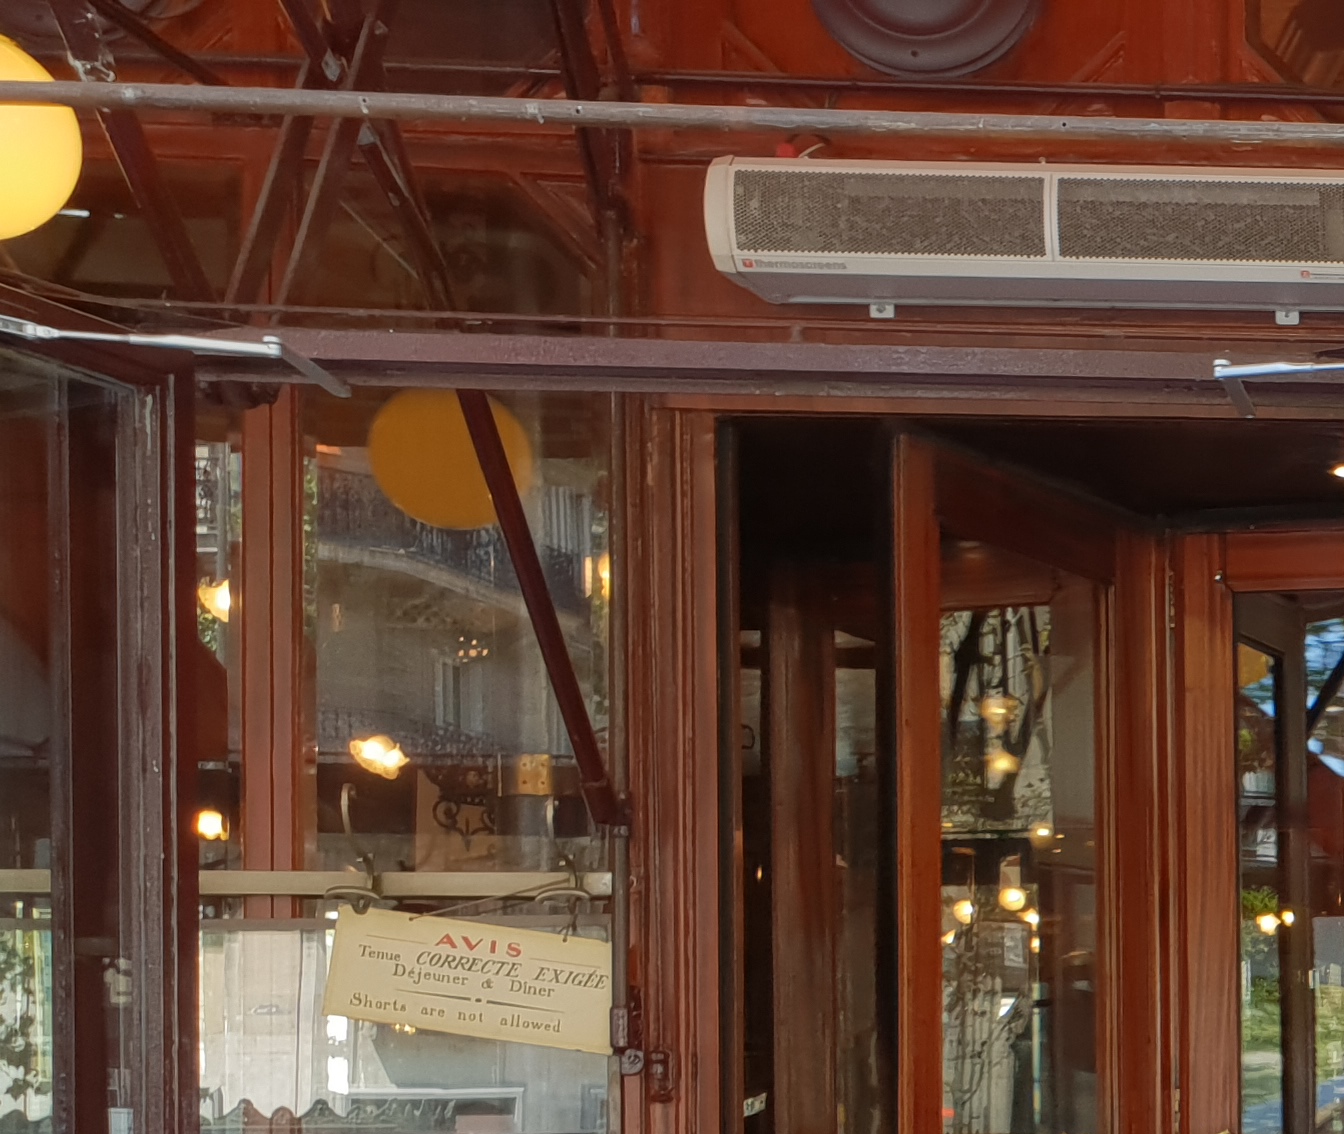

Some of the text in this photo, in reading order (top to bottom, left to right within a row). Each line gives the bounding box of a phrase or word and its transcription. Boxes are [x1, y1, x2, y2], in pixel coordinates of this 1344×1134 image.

[434, 932, 523, 958] AVIS
[358, 943, 610, 991] Tenue CORRECTE EXIGÉE
[392, 963, 556, 999] Déjeuner & Dîner
[349, 992, 563, 1034] Shorts are not allowed
